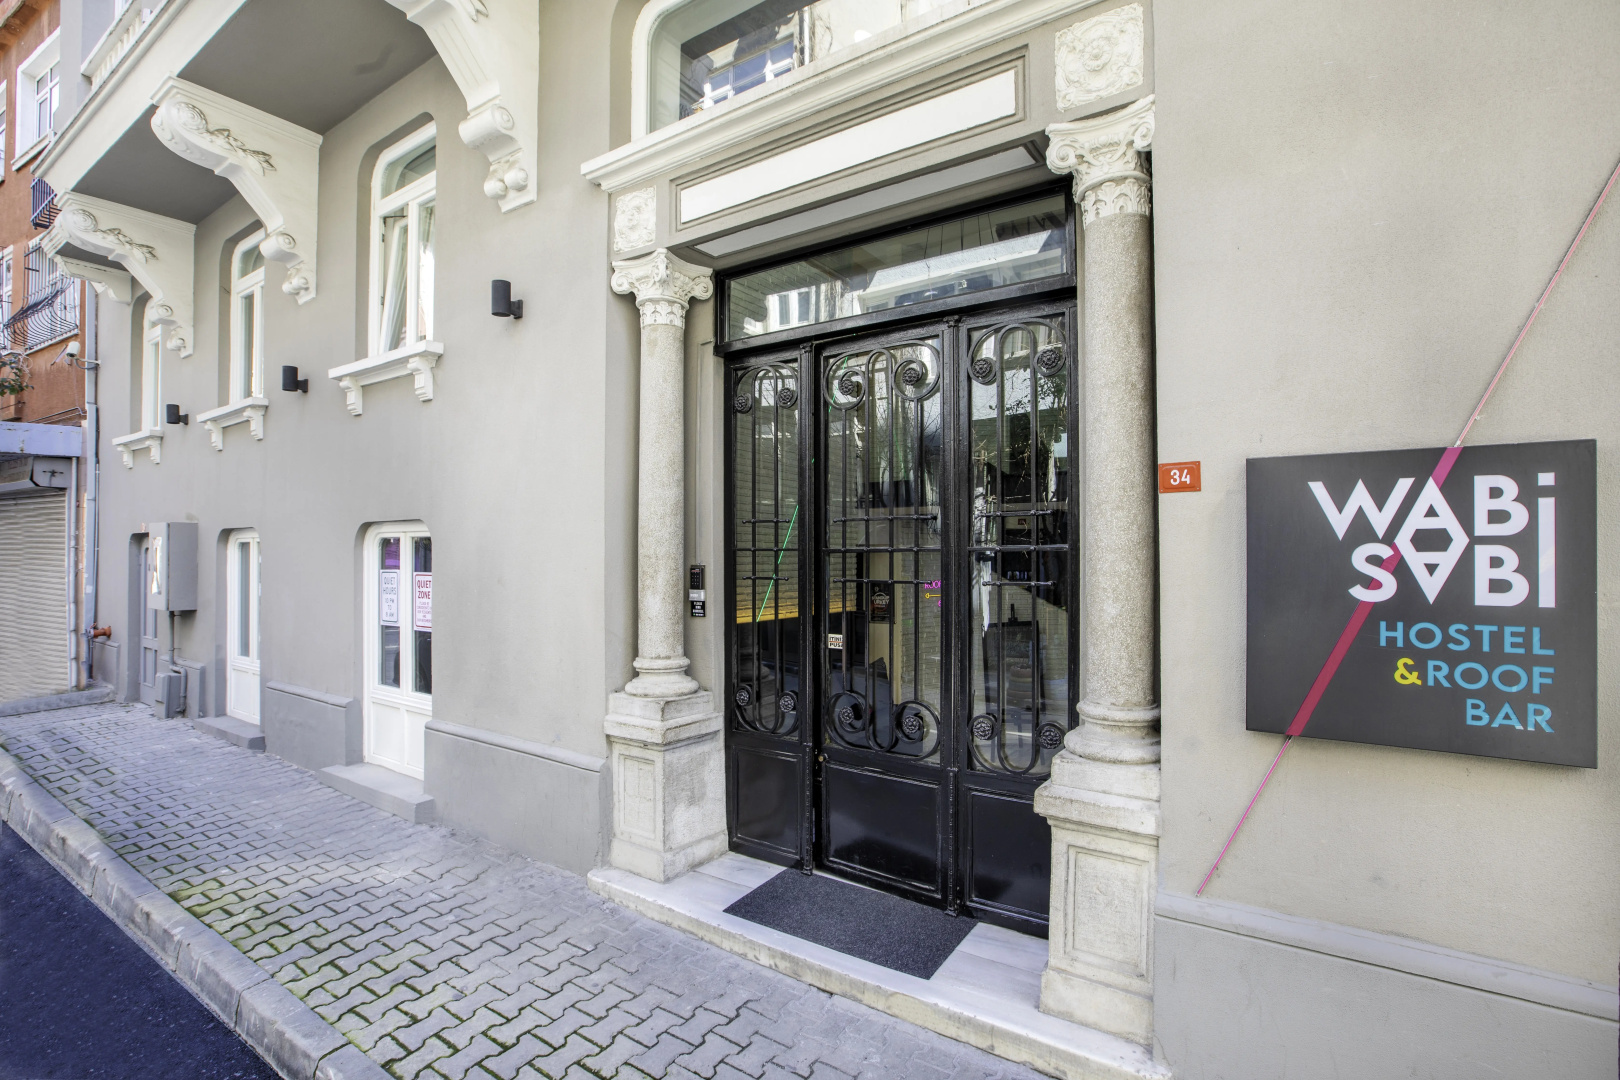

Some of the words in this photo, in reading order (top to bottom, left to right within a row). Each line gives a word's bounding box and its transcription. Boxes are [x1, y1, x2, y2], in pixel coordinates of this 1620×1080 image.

[1170, 469, 1190, 485] 34
[384, 576, 396, 585] QUIET
[417, 580, 432, 589] QUIET
[382, 586, 396, 595] HOURS
[418, 590, 431, 599] ZONE
[1379, 621, 1555, 656] HOSTEL
[1394, 657, 1422, 686] &
[1427, 660, 1555, 694] ROOF
[1466, 698, 1555, 733] BAR
